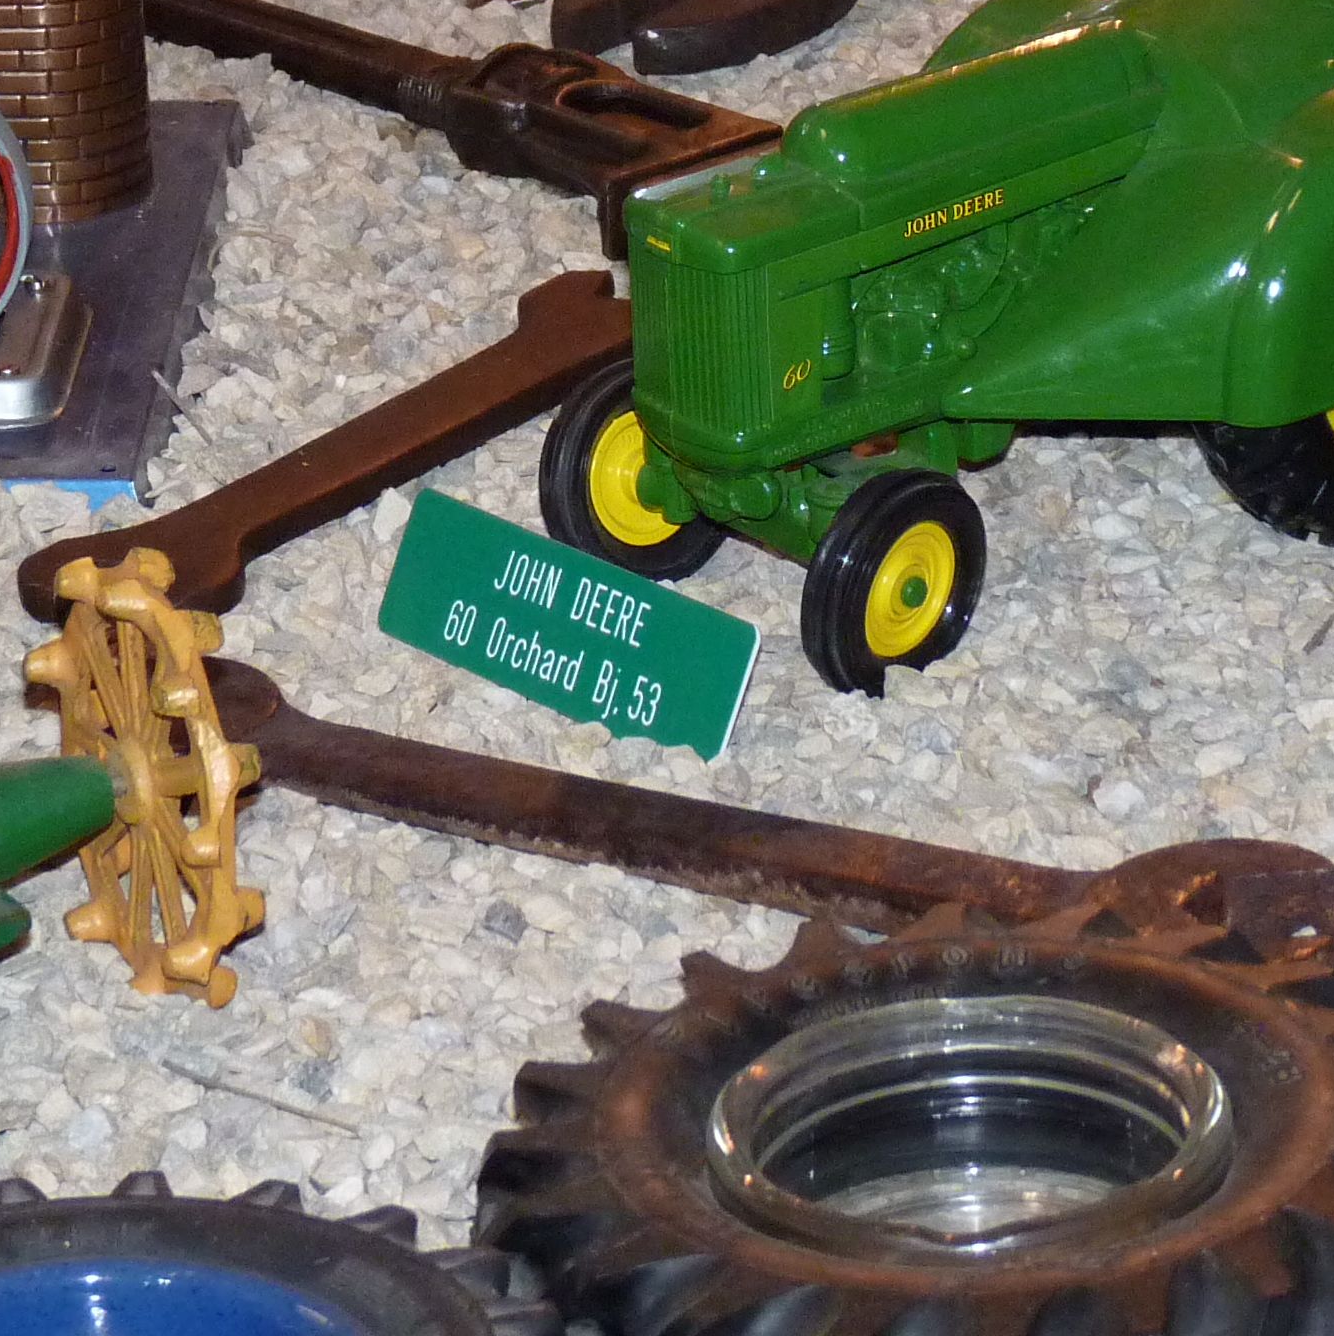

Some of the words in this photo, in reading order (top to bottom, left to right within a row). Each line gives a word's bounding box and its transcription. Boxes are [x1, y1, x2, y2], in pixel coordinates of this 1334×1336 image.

[903, 207, 948, 239] JOHN
[952, 188, 1005, 221] DEERE
[782, 358, 812, 391] 60
[493, 550, 564, 610] JOHN
[569, 576, 652, 648] DEERE
[442, 599, 478, 647] 60
[485, 616, 586, 692] Orchard
[591, 659, 623, 720] Bj.
[626, 674, 663, 727] 53
